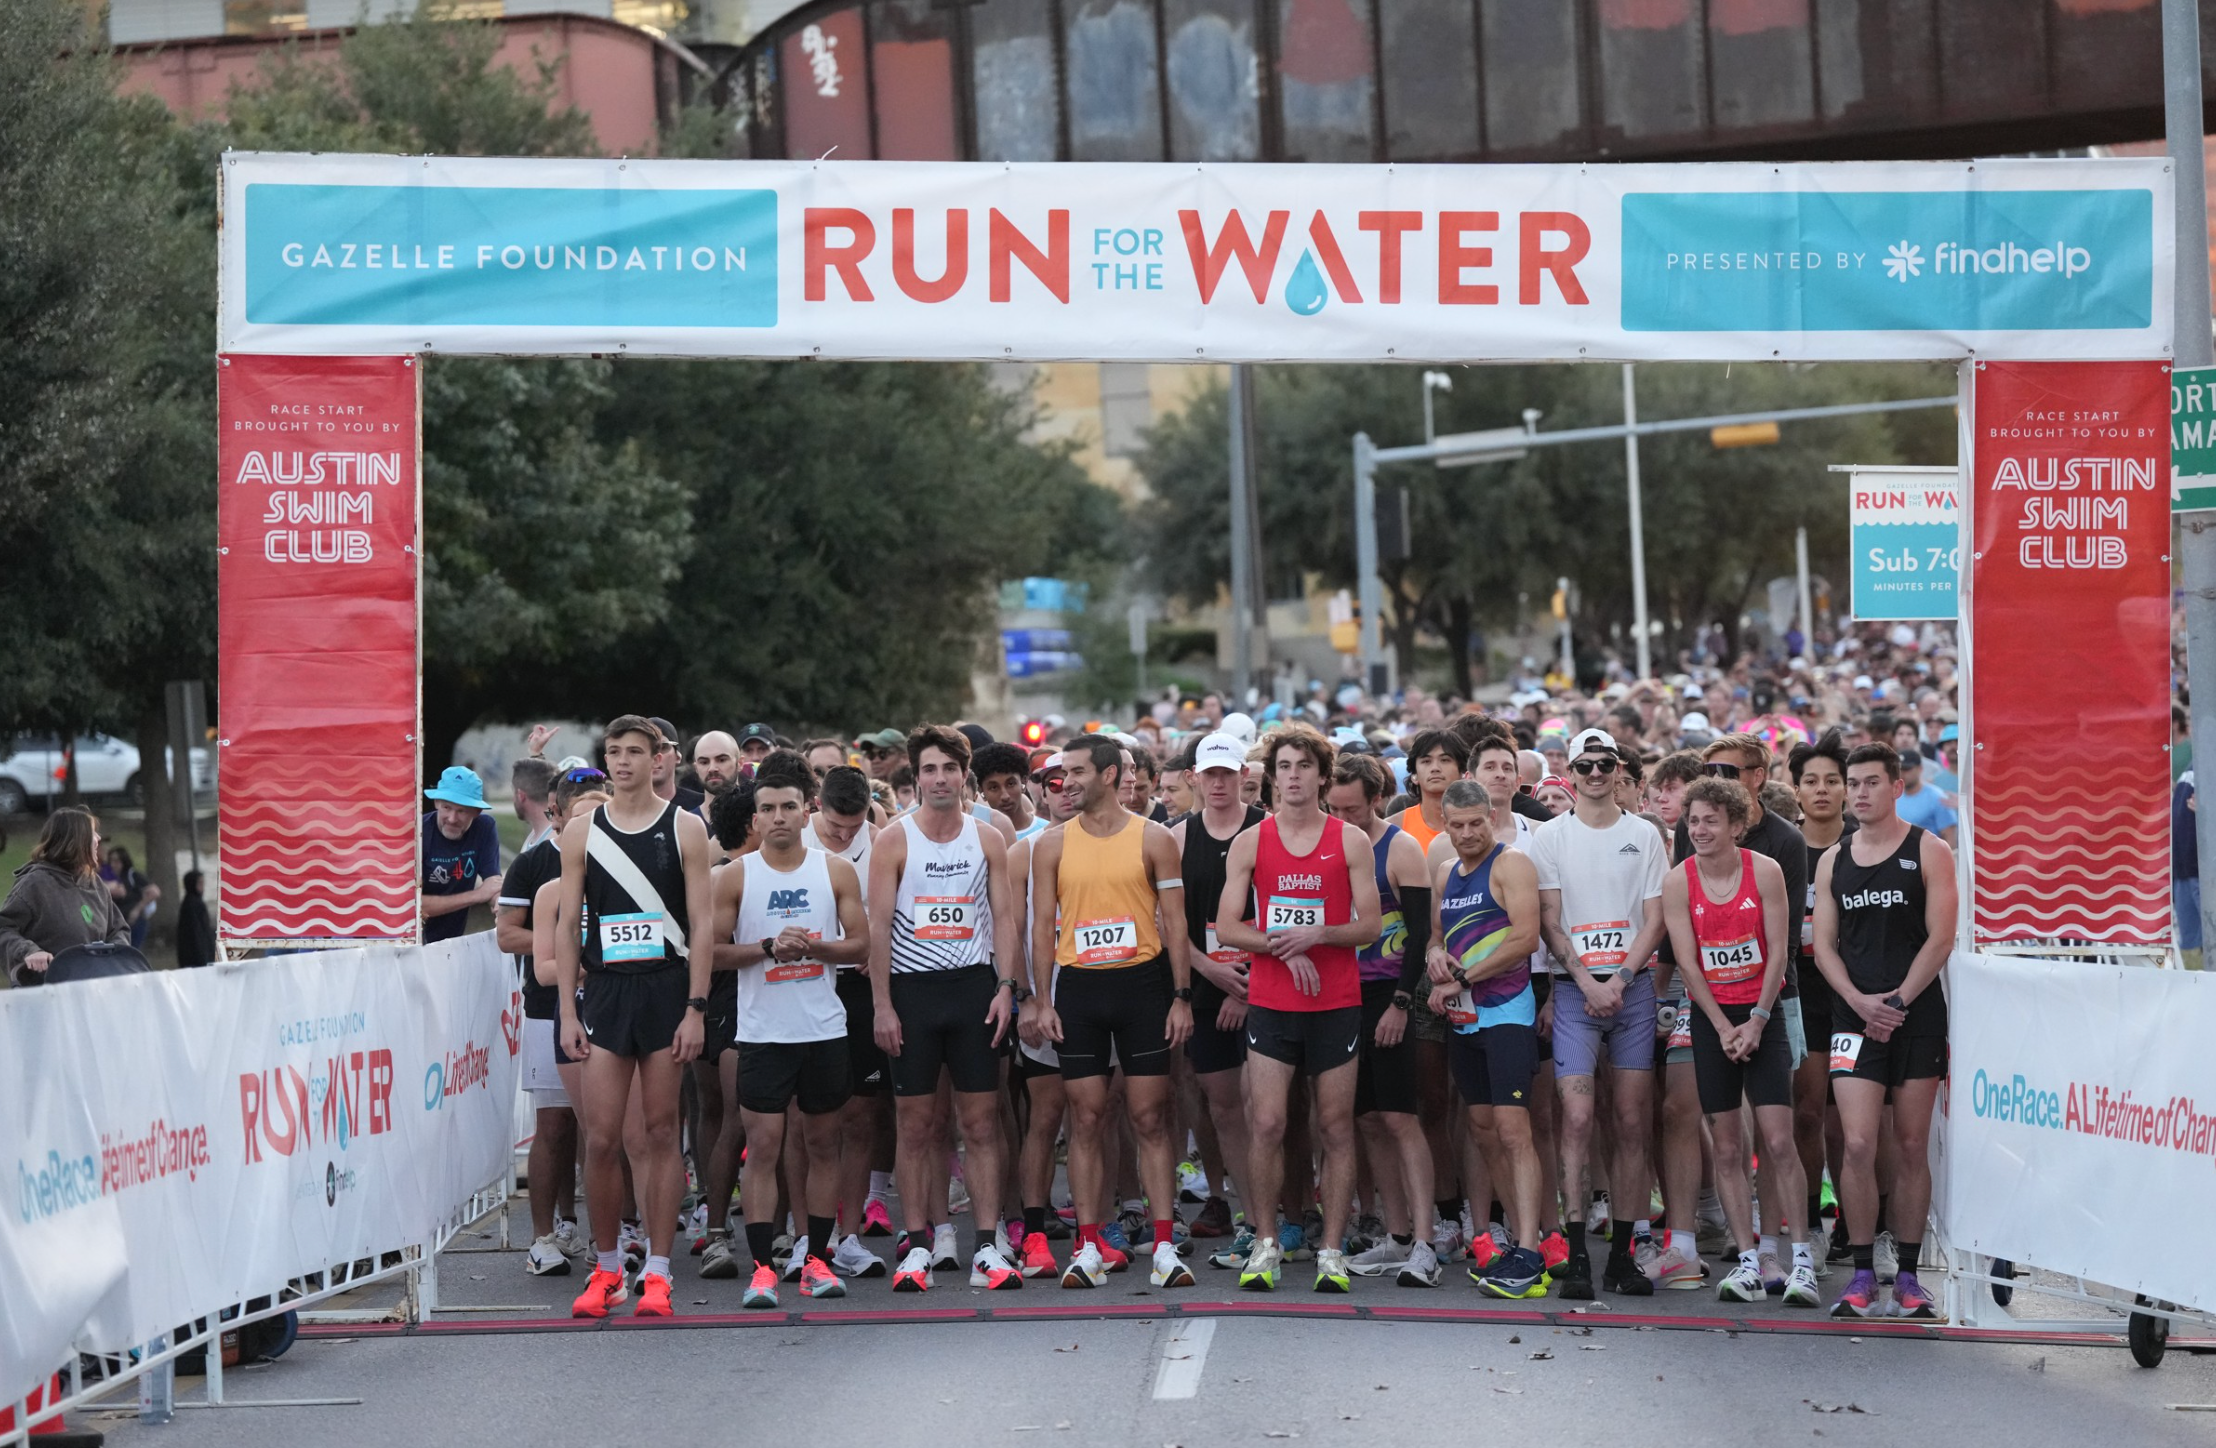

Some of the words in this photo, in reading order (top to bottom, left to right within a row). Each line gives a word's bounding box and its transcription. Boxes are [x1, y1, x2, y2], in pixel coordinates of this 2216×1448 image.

[1094, 229, 1163, 257] FOR
[281, 243, 455, 270] GAZELLE
[477, 244, 749, 272] FOUNDATION
[803, 207, 1070, 305] RUN
[1178, 208, 1592, 306] WATER
[1666, 252, 1822, 271] PRESENTED
[1836, 252, 1867, 270] BY
[1934, 240, 2092, 279] findhelp
[1091, 263, 1163, 291] THE
[271, 405, 310, 415] RACE
[319, 405, 364, 415] START
[2026, 411, 2066, 421] RACE
[2074, 411, 2119, 421] START
[235, 421, 308, 431] BROUGHT
[317, 422, 335, 432] TO
[343, 422, 374, 432] YOU
[382, 423, 400, 432] BY
[1990, 428, 2063, 438] BROUGHT
[2071, 428, 2090, 438] TO
[2099, 428, 2129, 438] YOU
[2138, 428, 2155, 438] BY
[235, 451, 400, 485] AUSTIN
[1991, 457, 2156, 491] AUSTIN
[263, 491, 373, 524] SWIM
[1856, 491, 1905, 510] RUN
[2018, 497, 2128, 530] SWIM
[264, 530, 373, 563] CLUB
[2019, 536, 2128, 569] CLUB
[1869, 547, 1918, 572] Sub
[1873, 583, 1923, 591] MINUTES
[1931, 583, 1952, 591] PER
[925, 859, 971, 873] Maverick
[1278, 873, 1322, 883] DALLAS
[1278, 882, 1322, 891] BAPTIST
[767, 888, 810, 910] ARC
[1842, 889, 1904, 910] balega
[929, 907, 964, 923] 650
[1274, 907, 1316, 925] 5783
[611, 924, 652, 943] 5512
[1083, 927, 1125, 946] 1207
[1582, 932, 1623, 950] 1472
[1709, 946, 1753, 966] 1045
